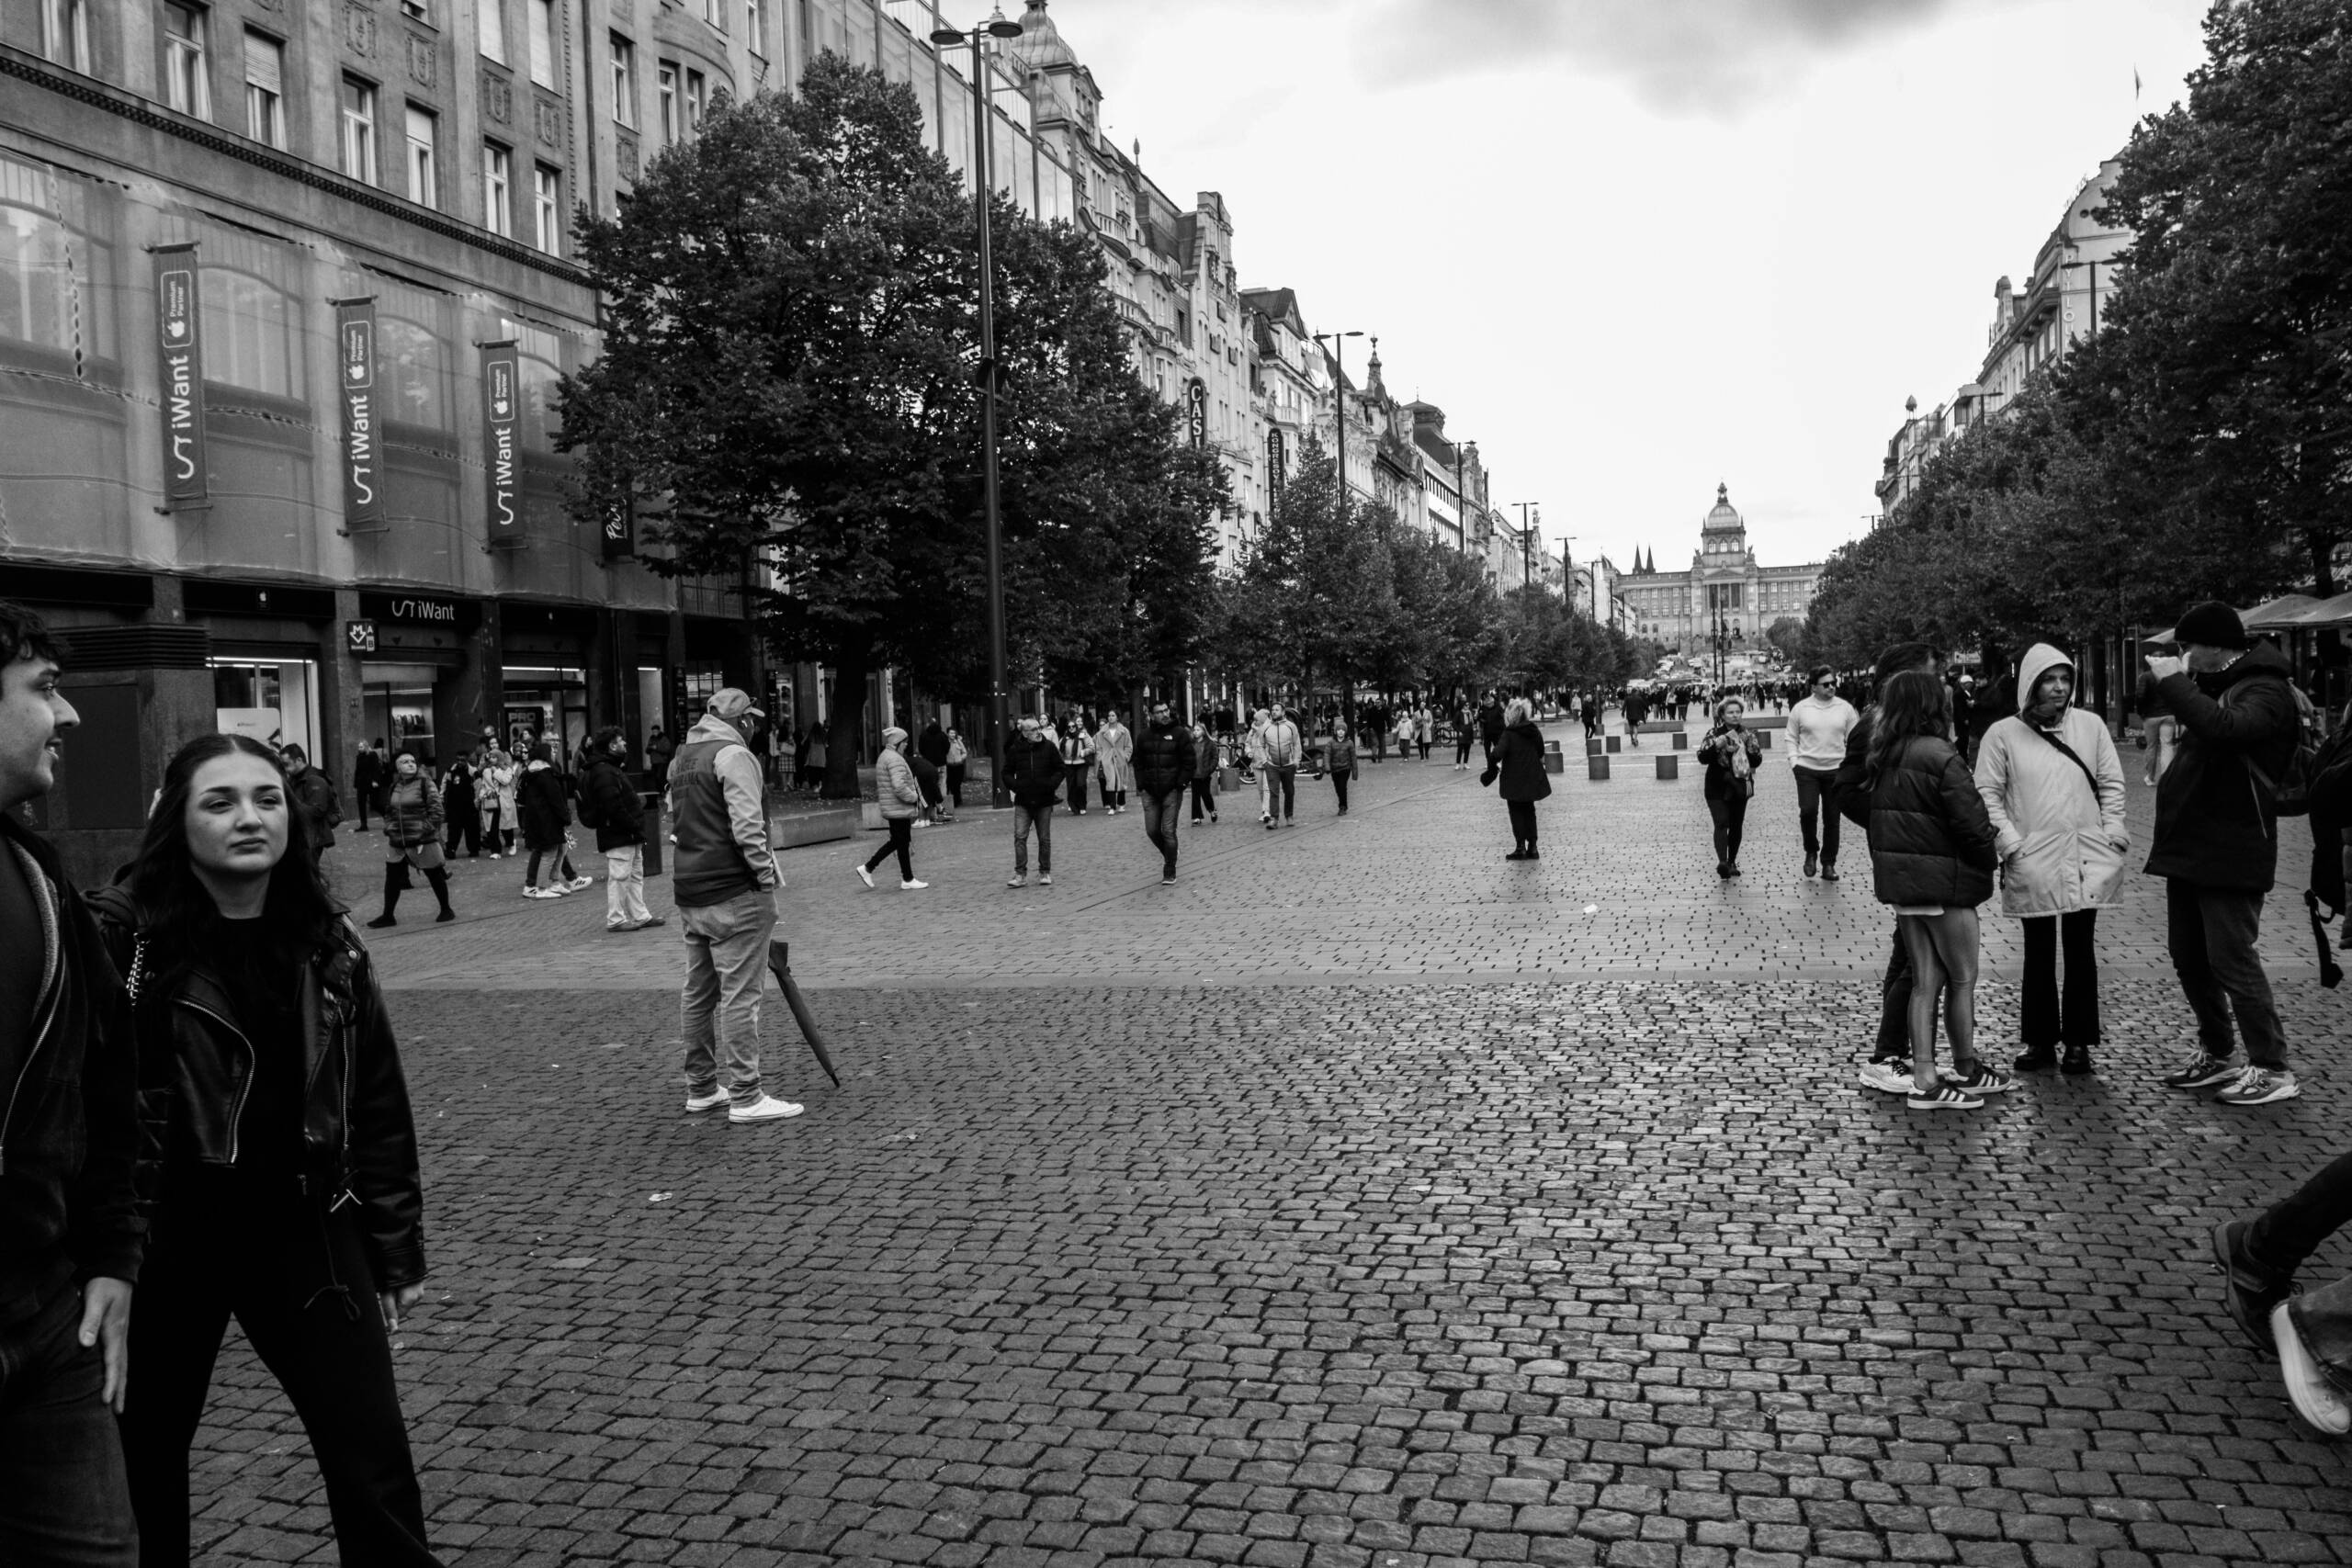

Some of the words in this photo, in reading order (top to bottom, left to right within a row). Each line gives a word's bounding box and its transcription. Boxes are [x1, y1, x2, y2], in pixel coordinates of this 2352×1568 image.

[169, 355, 191, 429] iWant
[1191, 385, 1203, 448] CASI
[350, 395, 371, 460] iWant
[495, 427, 514, 486] iWant
[1272, 433, 1281, 485] KONGRESOV
[418, 600, 455, 620] iWant
